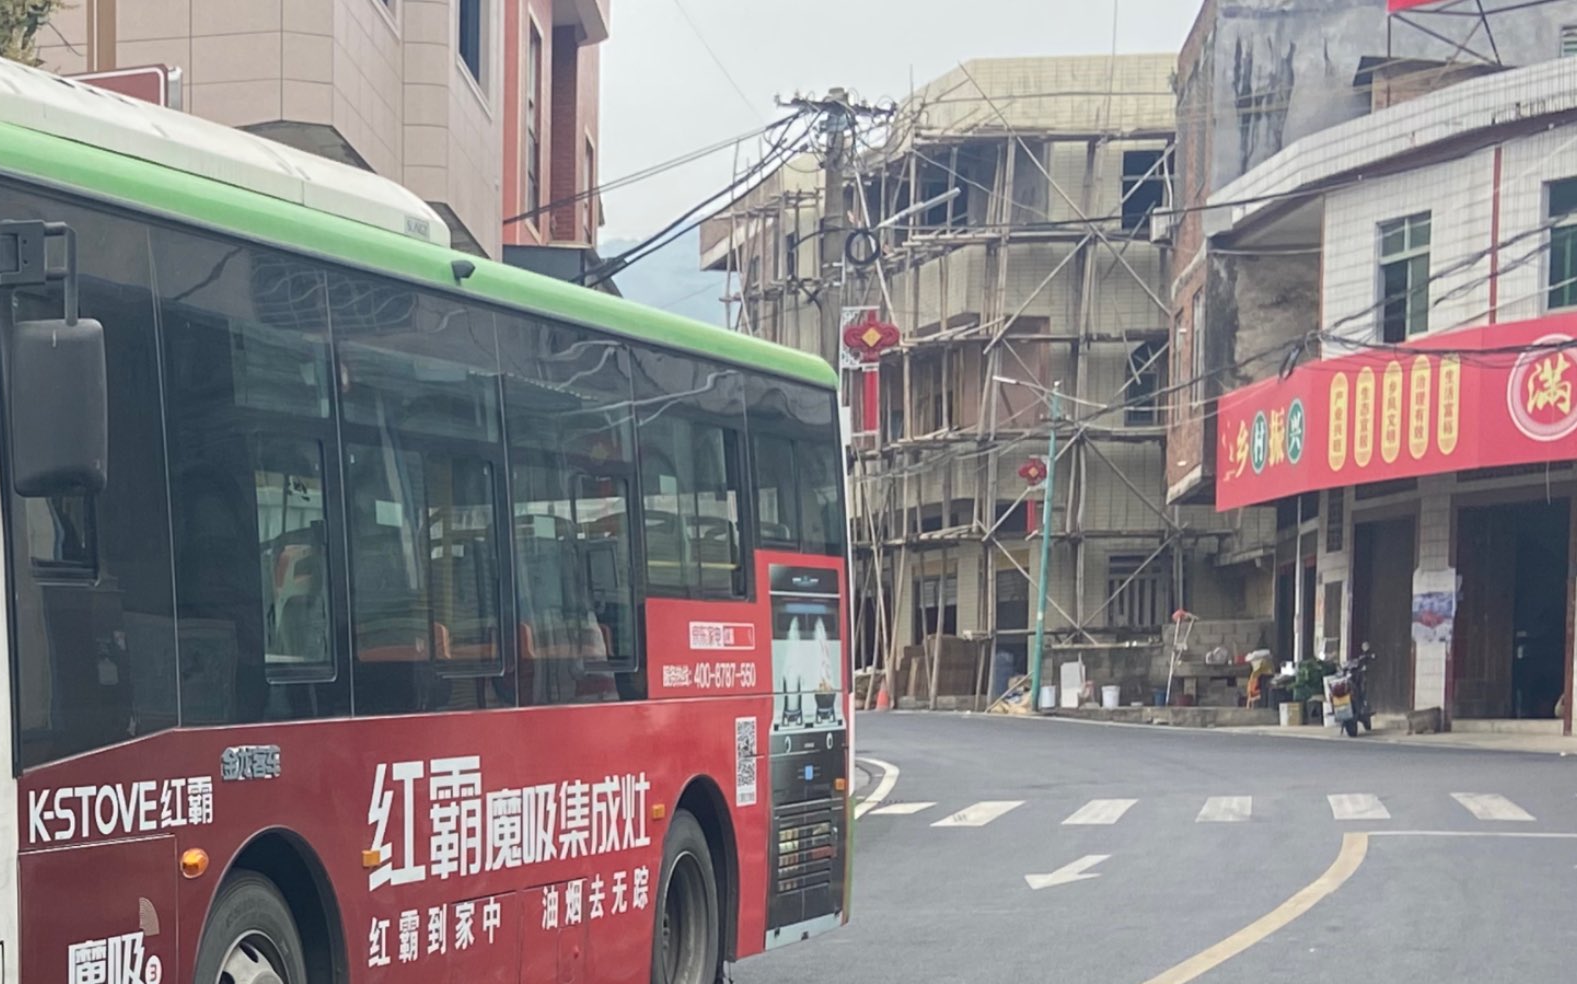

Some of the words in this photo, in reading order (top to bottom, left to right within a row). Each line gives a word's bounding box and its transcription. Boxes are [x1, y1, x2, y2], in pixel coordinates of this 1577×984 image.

[1527, 352, 1571, 415] 满
[1235, 405, 1303, 478] 乡村振兴
[368, 896, 501, 967] 红霸到家中
[542, 865, 649, 930] 油烟去无踪
